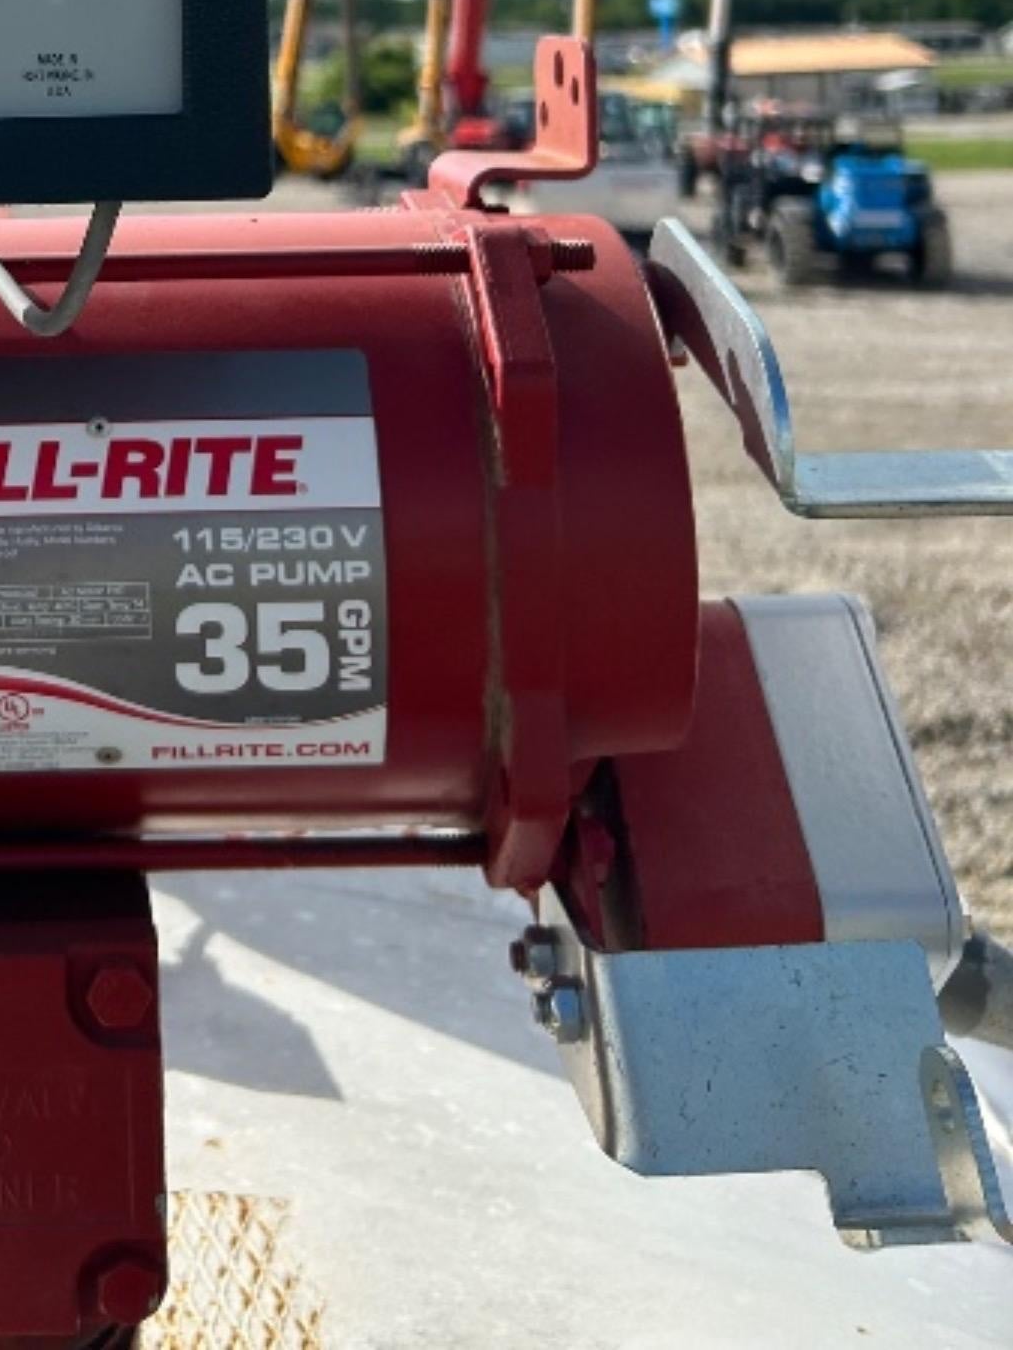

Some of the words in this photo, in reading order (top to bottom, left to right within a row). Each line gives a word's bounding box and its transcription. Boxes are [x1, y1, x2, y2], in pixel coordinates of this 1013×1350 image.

[172, 526, 334, 553] 115/230
[340, 524, 368, 547] V
[175, 564, 235, 588] AC
[250, 561, 371, 587] PUMP
[174, 601, 331, 695] 35
[337, 598, 372, 692] GPM
[150, 740, 371, 761] FILLRITE.COM
